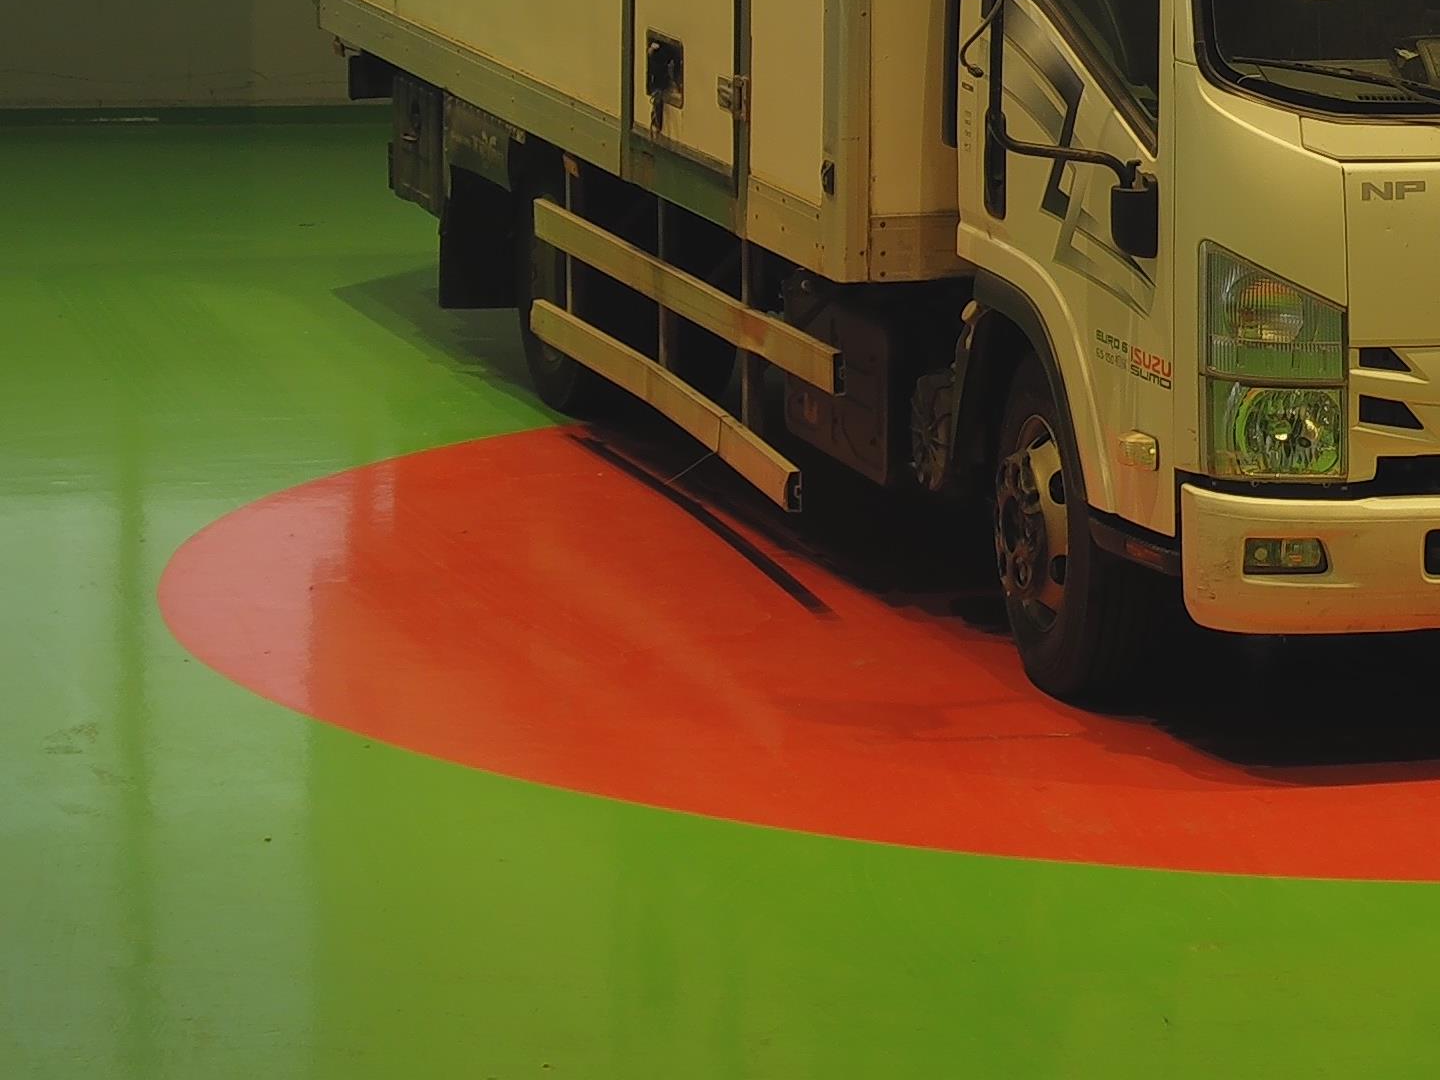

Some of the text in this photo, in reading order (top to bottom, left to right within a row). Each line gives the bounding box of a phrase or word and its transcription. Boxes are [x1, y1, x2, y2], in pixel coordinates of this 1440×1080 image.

[1361, 180, 1425, 201] NP
[1095, 329, 1129, 354] EURO 6
[1130, 345, 1172, 378] ISUZU
[1130, 364, 1172, 390] SUMO
